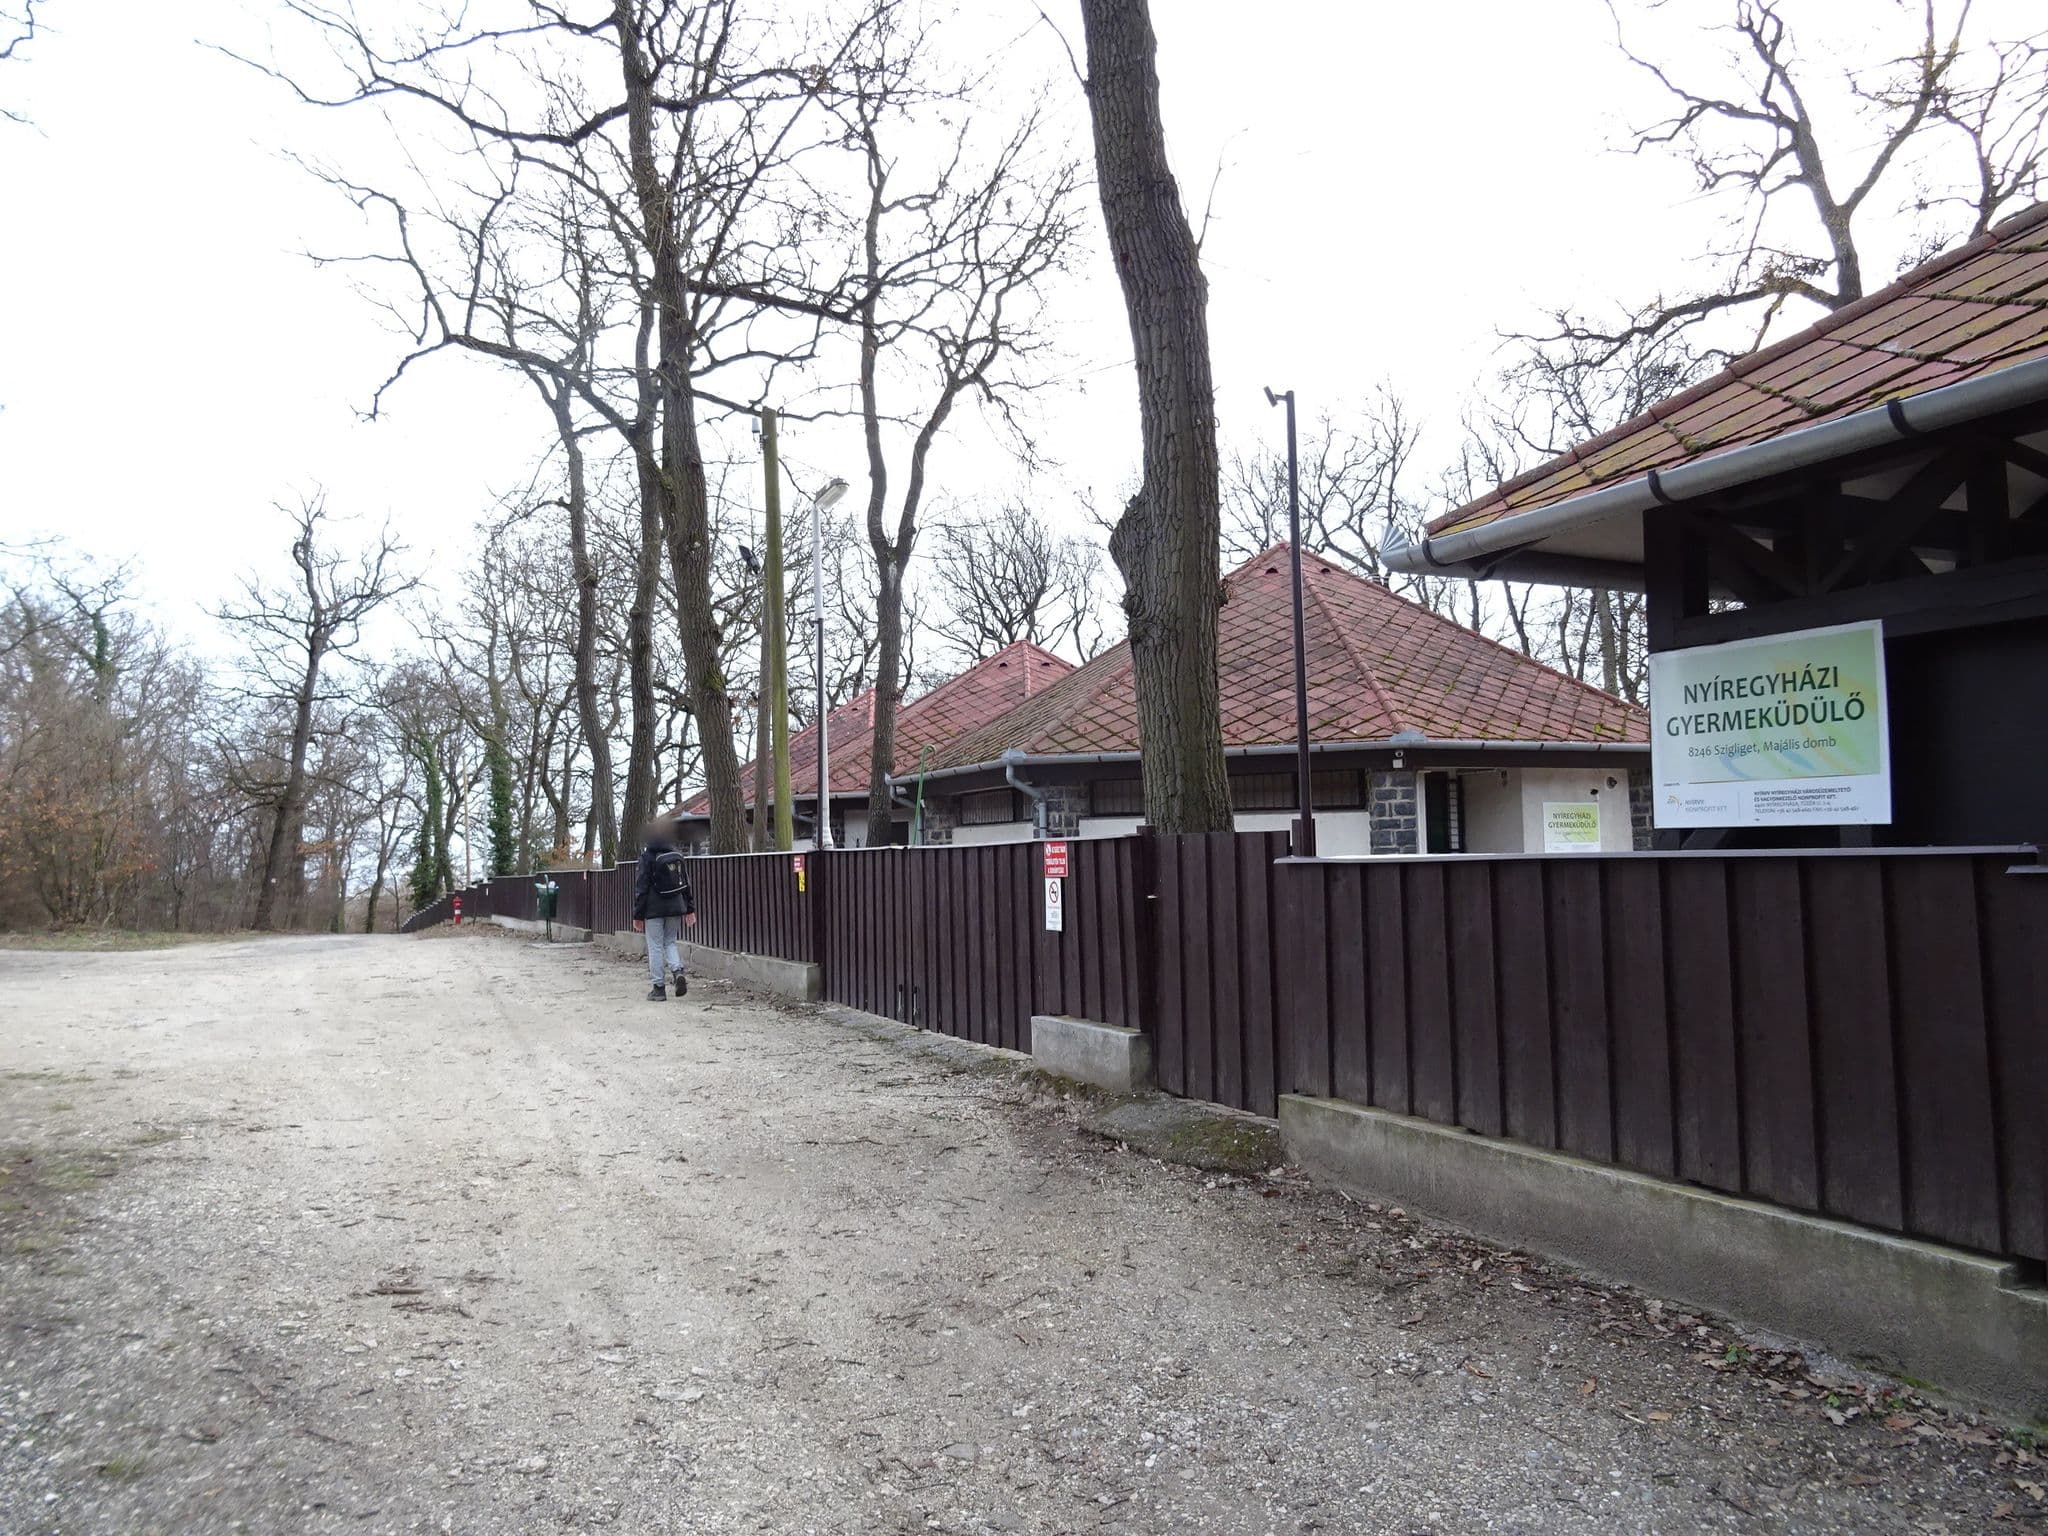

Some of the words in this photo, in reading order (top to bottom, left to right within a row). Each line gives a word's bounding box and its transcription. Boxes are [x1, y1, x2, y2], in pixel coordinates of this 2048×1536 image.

[1683, 663, 1839, 704] NYÍREGYHÁZI
[1666, 691, 1865, 736] GYERMEKÜDÜLŐ
[1688, 746, 1712, 758] 8246
[1714, 742, 1760, 758] Szigliget,
[1763, 738, 1800, 755] Majális
[1802, 736, 1836, 749] domb
